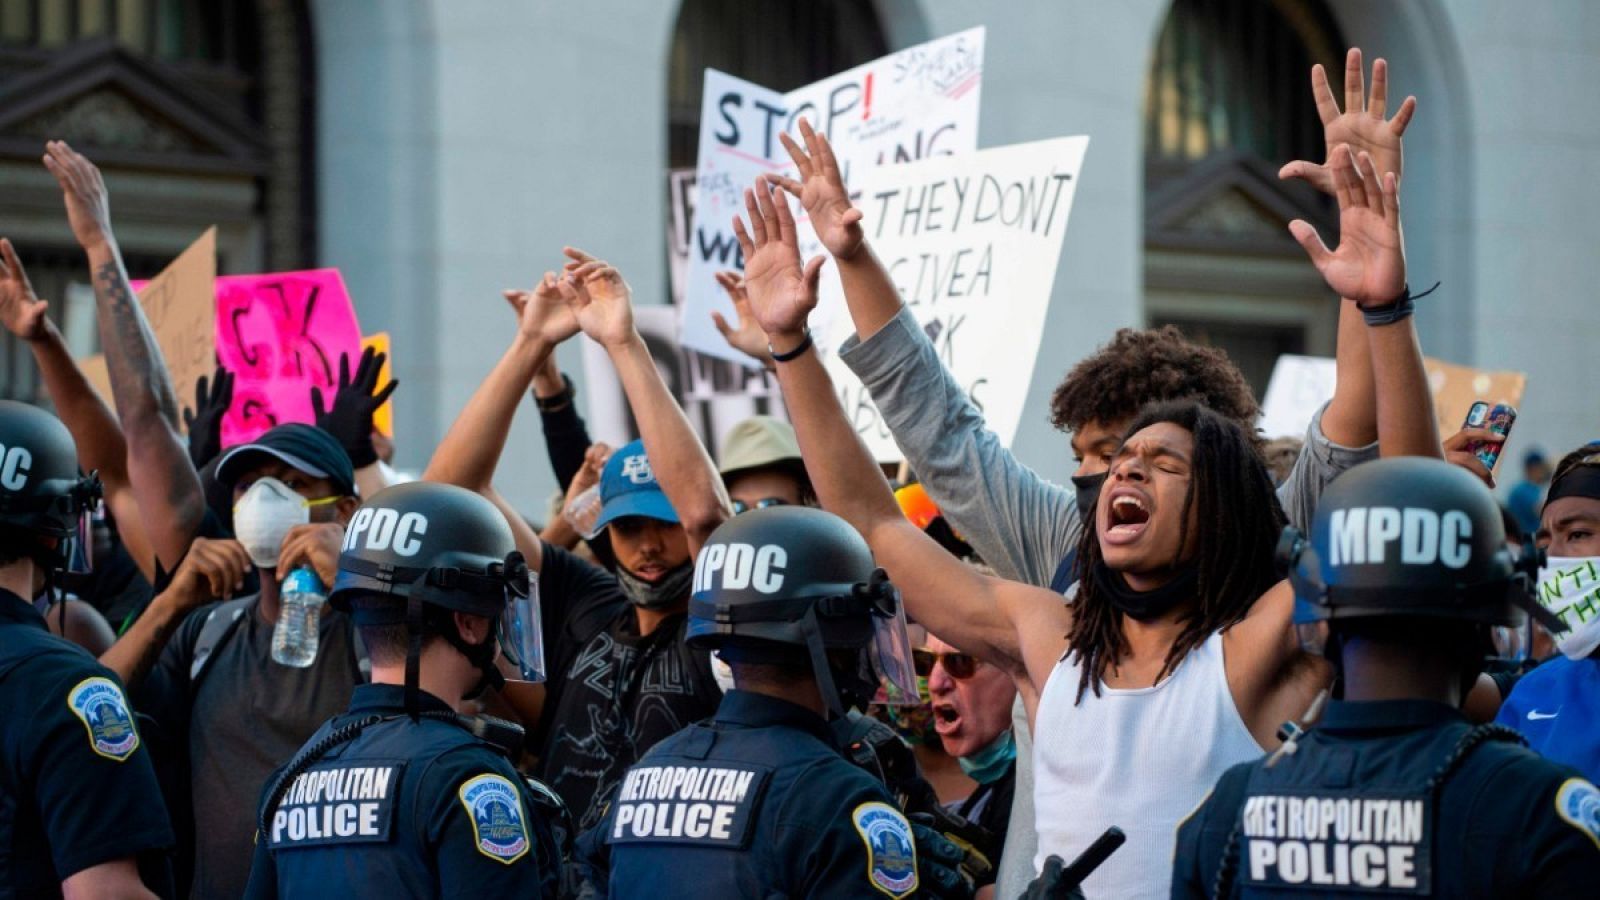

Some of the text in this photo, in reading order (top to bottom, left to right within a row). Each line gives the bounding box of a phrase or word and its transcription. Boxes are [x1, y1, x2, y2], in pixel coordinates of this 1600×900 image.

[874, 176, 970, 239] THEY
[1329, 506, 1473, 569] MPDC
[279, 767, 392, 806] TROPOLITAN
[619, 766, 755, 803] METROPOLITAN
[272, 803, 379, 843] POLICE
[613, 802, 736, 839] POLICE
[1243, 796, 1424, 843] METROPOLITAN
[1249, 839, 1417, 888] POLICE
